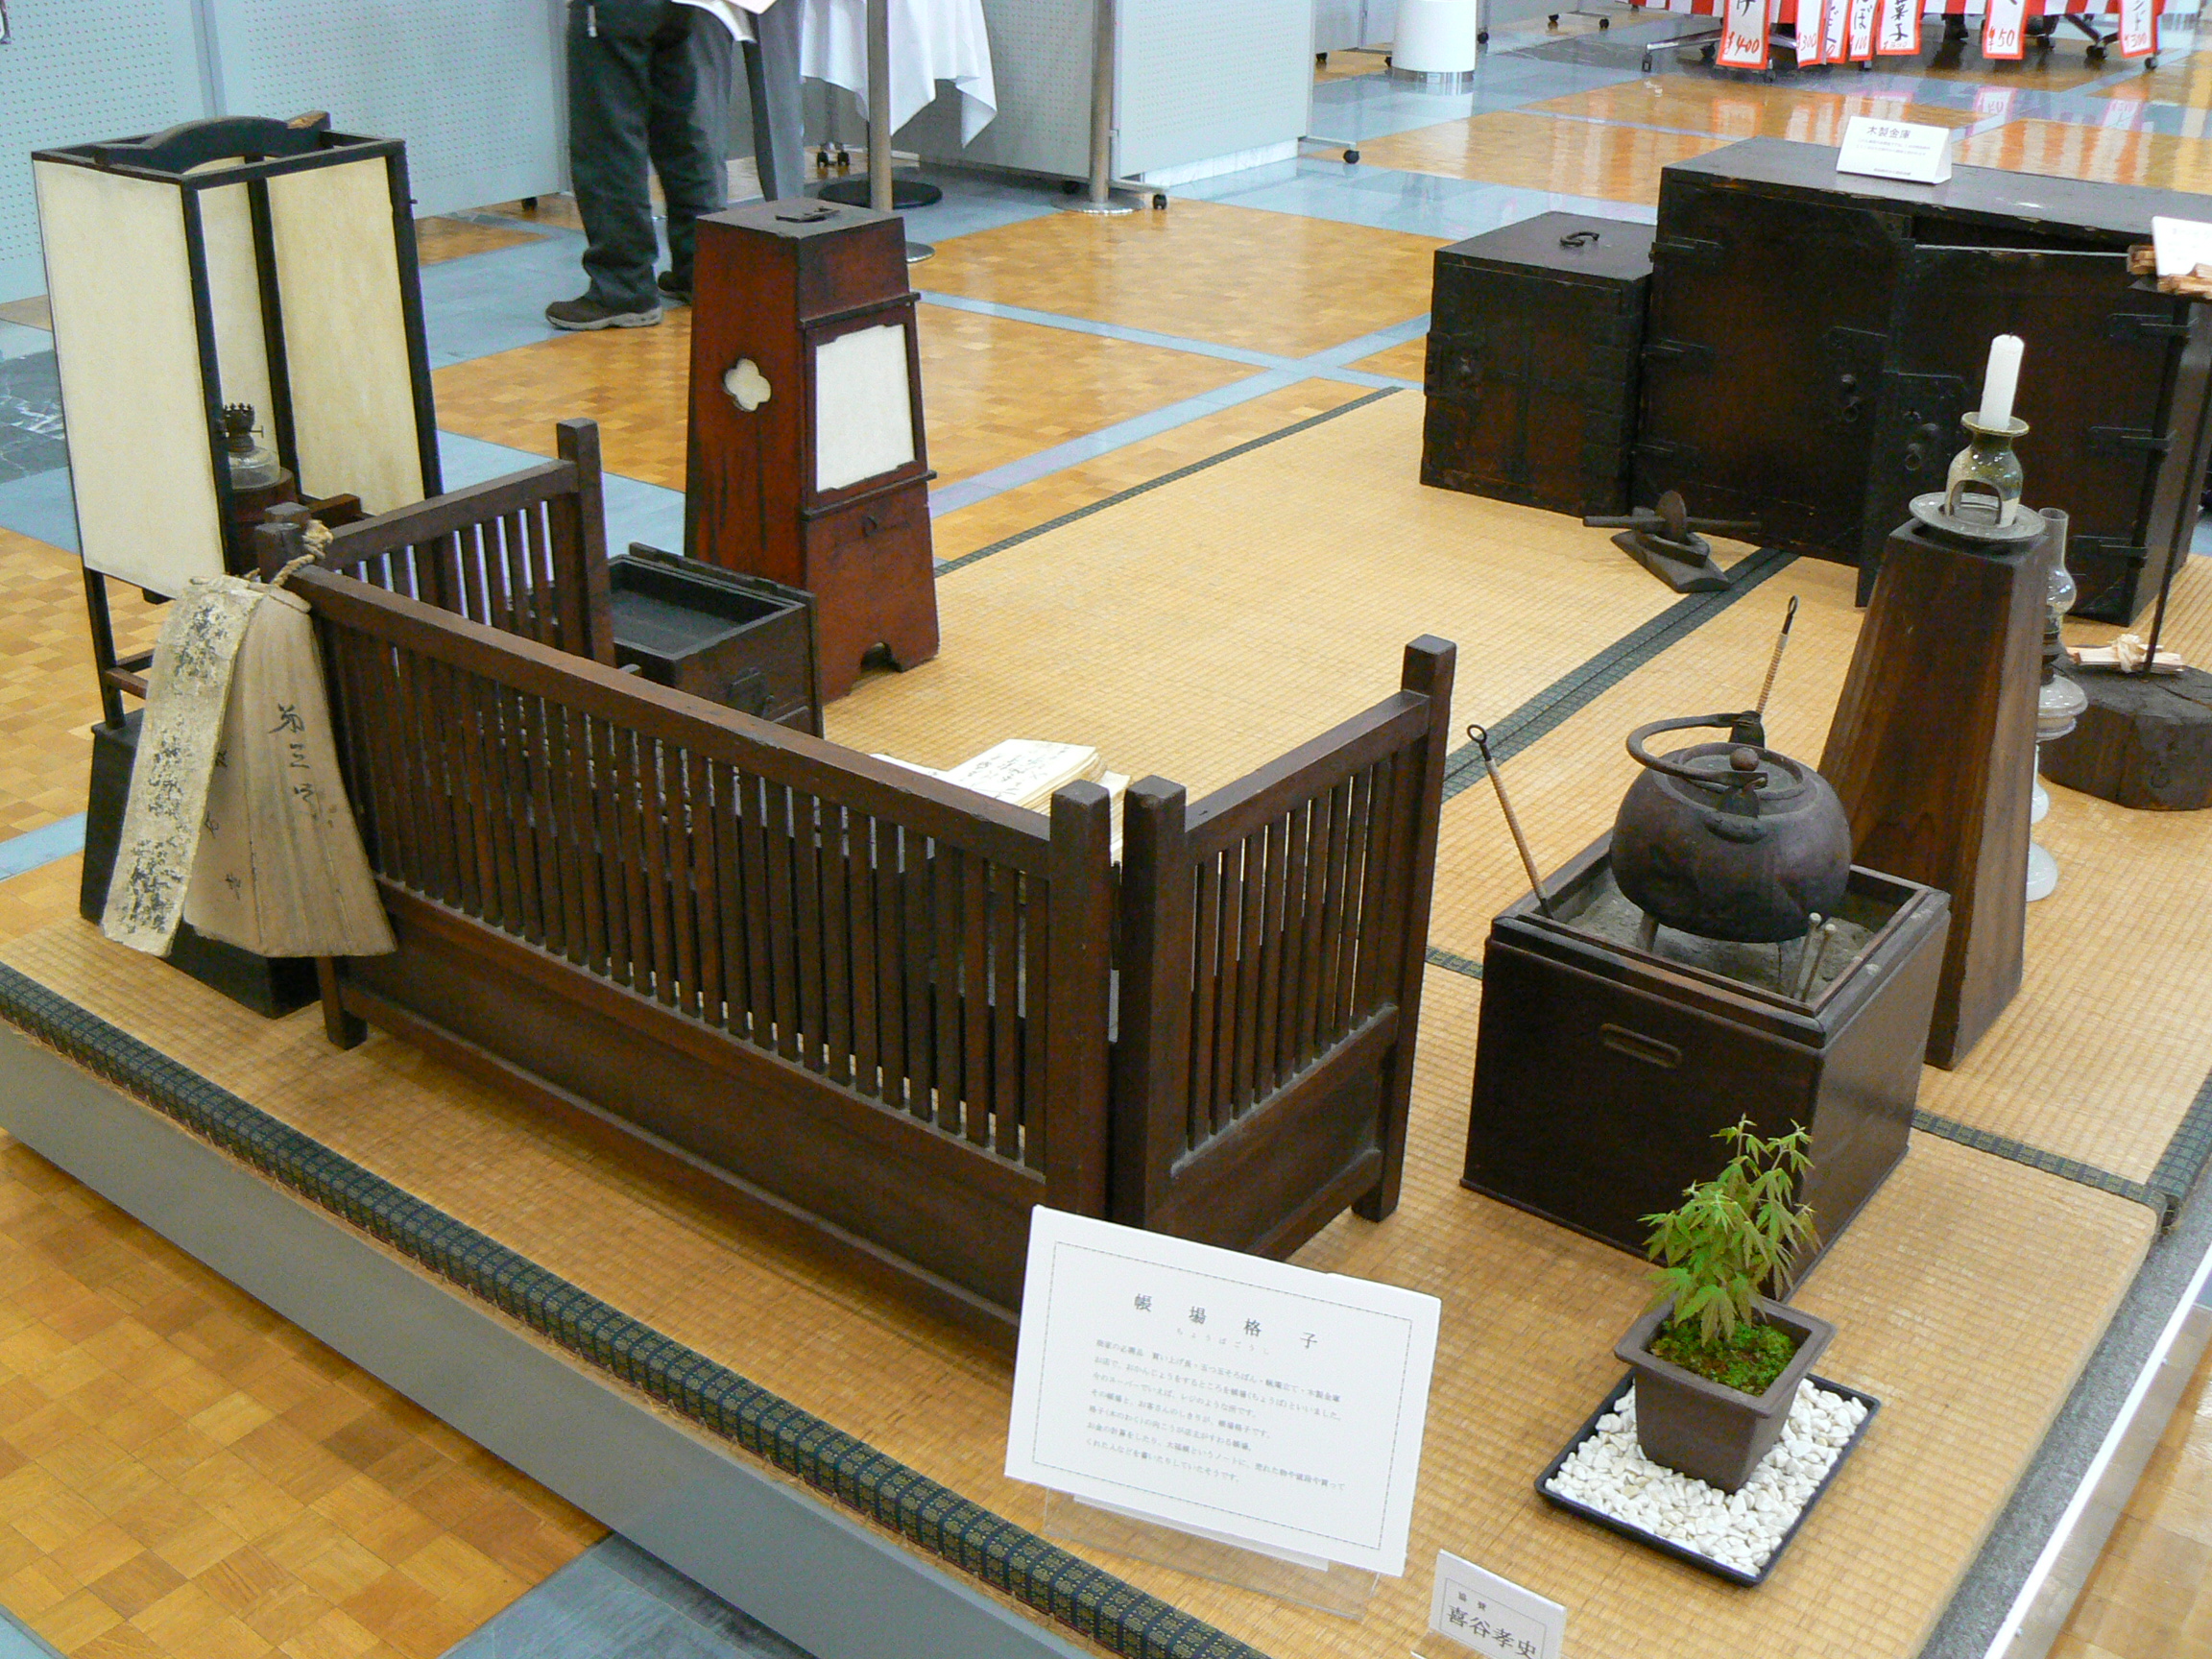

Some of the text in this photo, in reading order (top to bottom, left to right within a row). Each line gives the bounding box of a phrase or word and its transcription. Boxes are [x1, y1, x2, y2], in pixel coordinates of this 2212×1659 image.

[1722, 31, 1761, 56] ¥400
[1987, 26, 2015, 51] ¥50
[1866, 125, 1911, 140] 木製金庫
